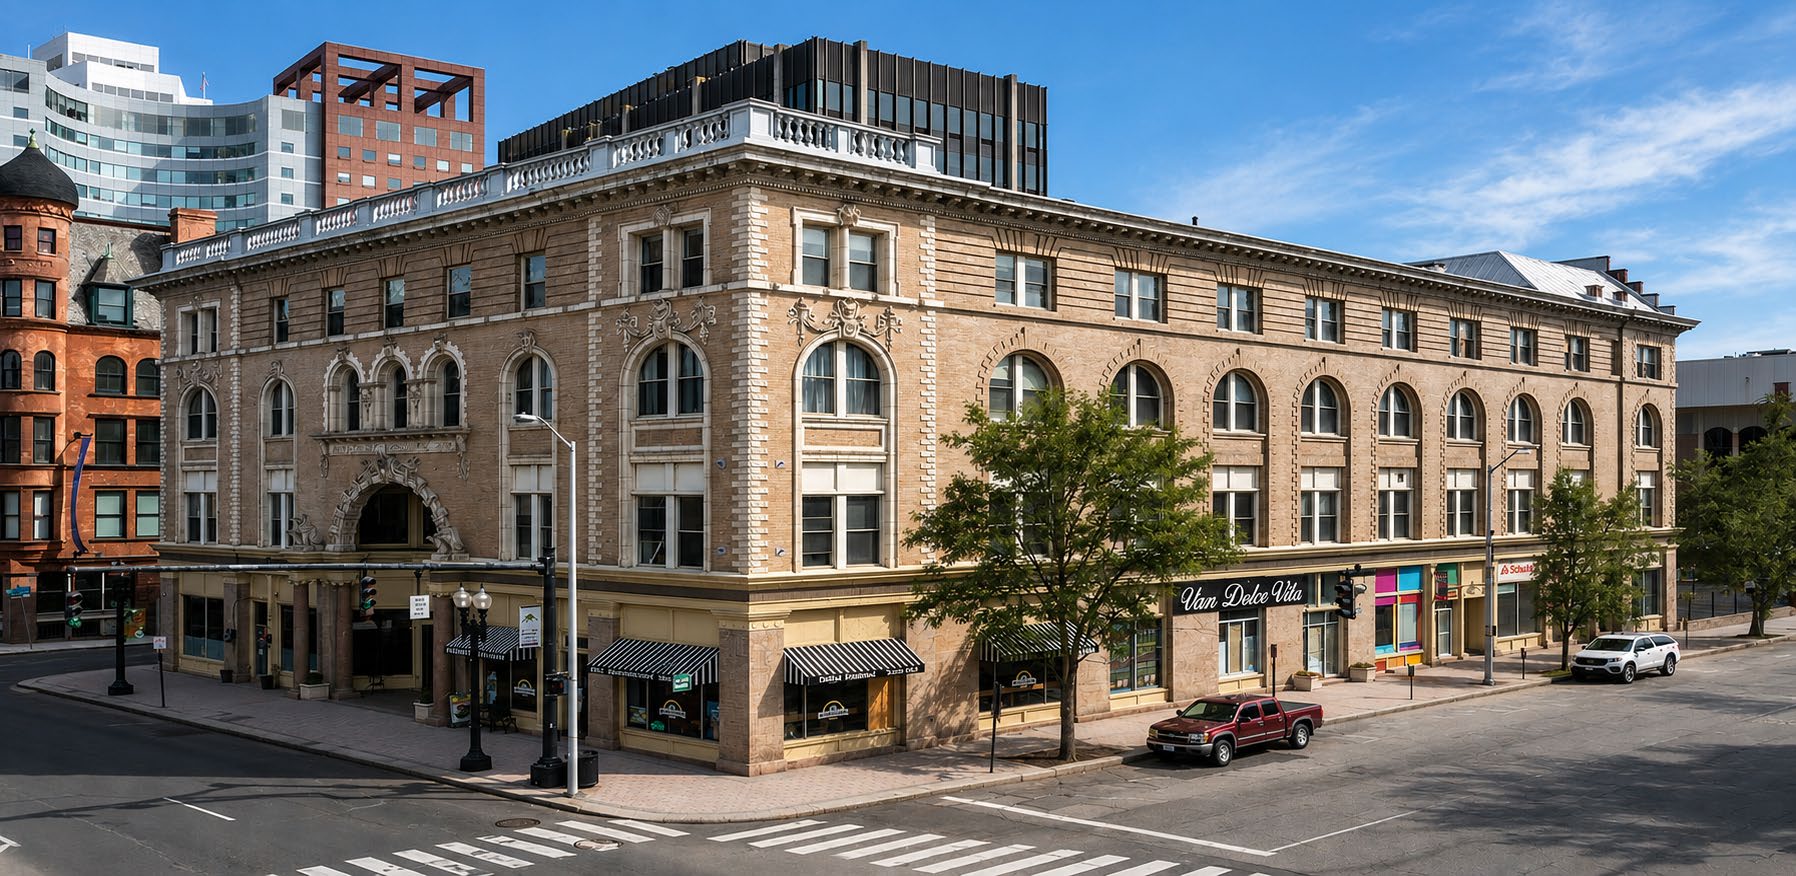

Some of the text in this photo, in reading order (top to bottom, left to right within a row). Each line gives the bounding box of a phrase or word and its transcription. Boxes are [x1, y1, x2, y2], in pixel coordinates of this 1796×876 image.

[1180, 580, 1303, 611] Van Delce Vita
